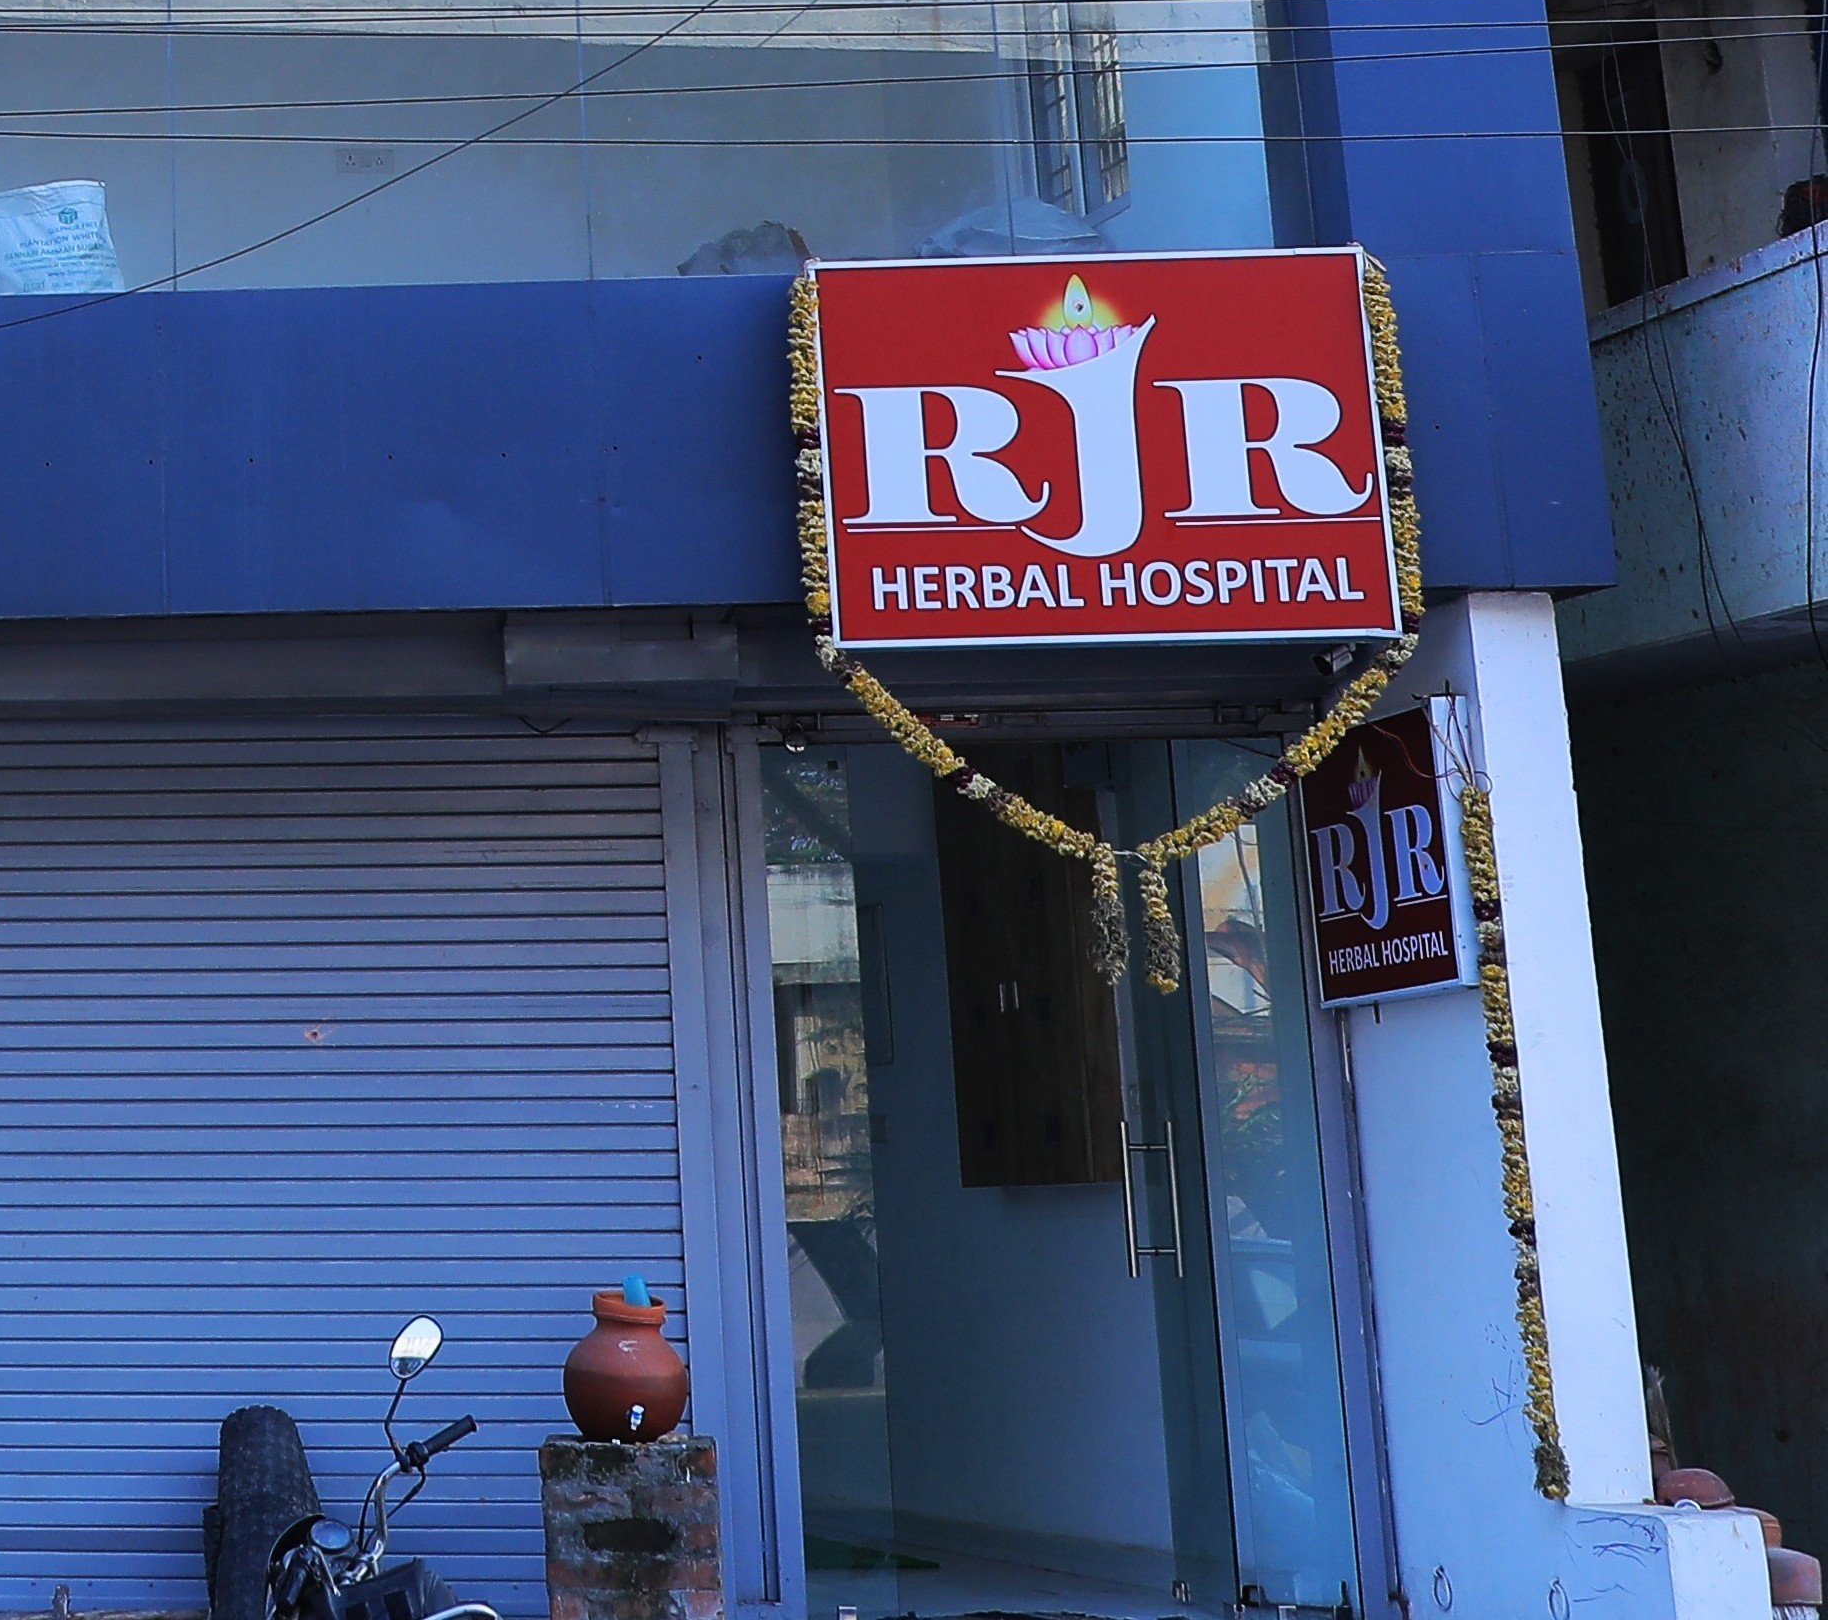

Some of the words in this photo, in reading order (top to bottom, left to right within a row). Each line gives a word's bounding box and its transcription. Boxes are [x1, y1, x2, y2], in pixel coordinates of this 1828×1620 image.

[833, 313, 1374, 557] RJR
[871, 562, 1084, 611] HERBAL
[1098, 556, 1365, 607] HOSPITAL
[1310, 768, 1445, 930] RJR
[1328, 940, 1380, 976] HERBAL
[1381, 932, 1449, 966] HOSPITAL
